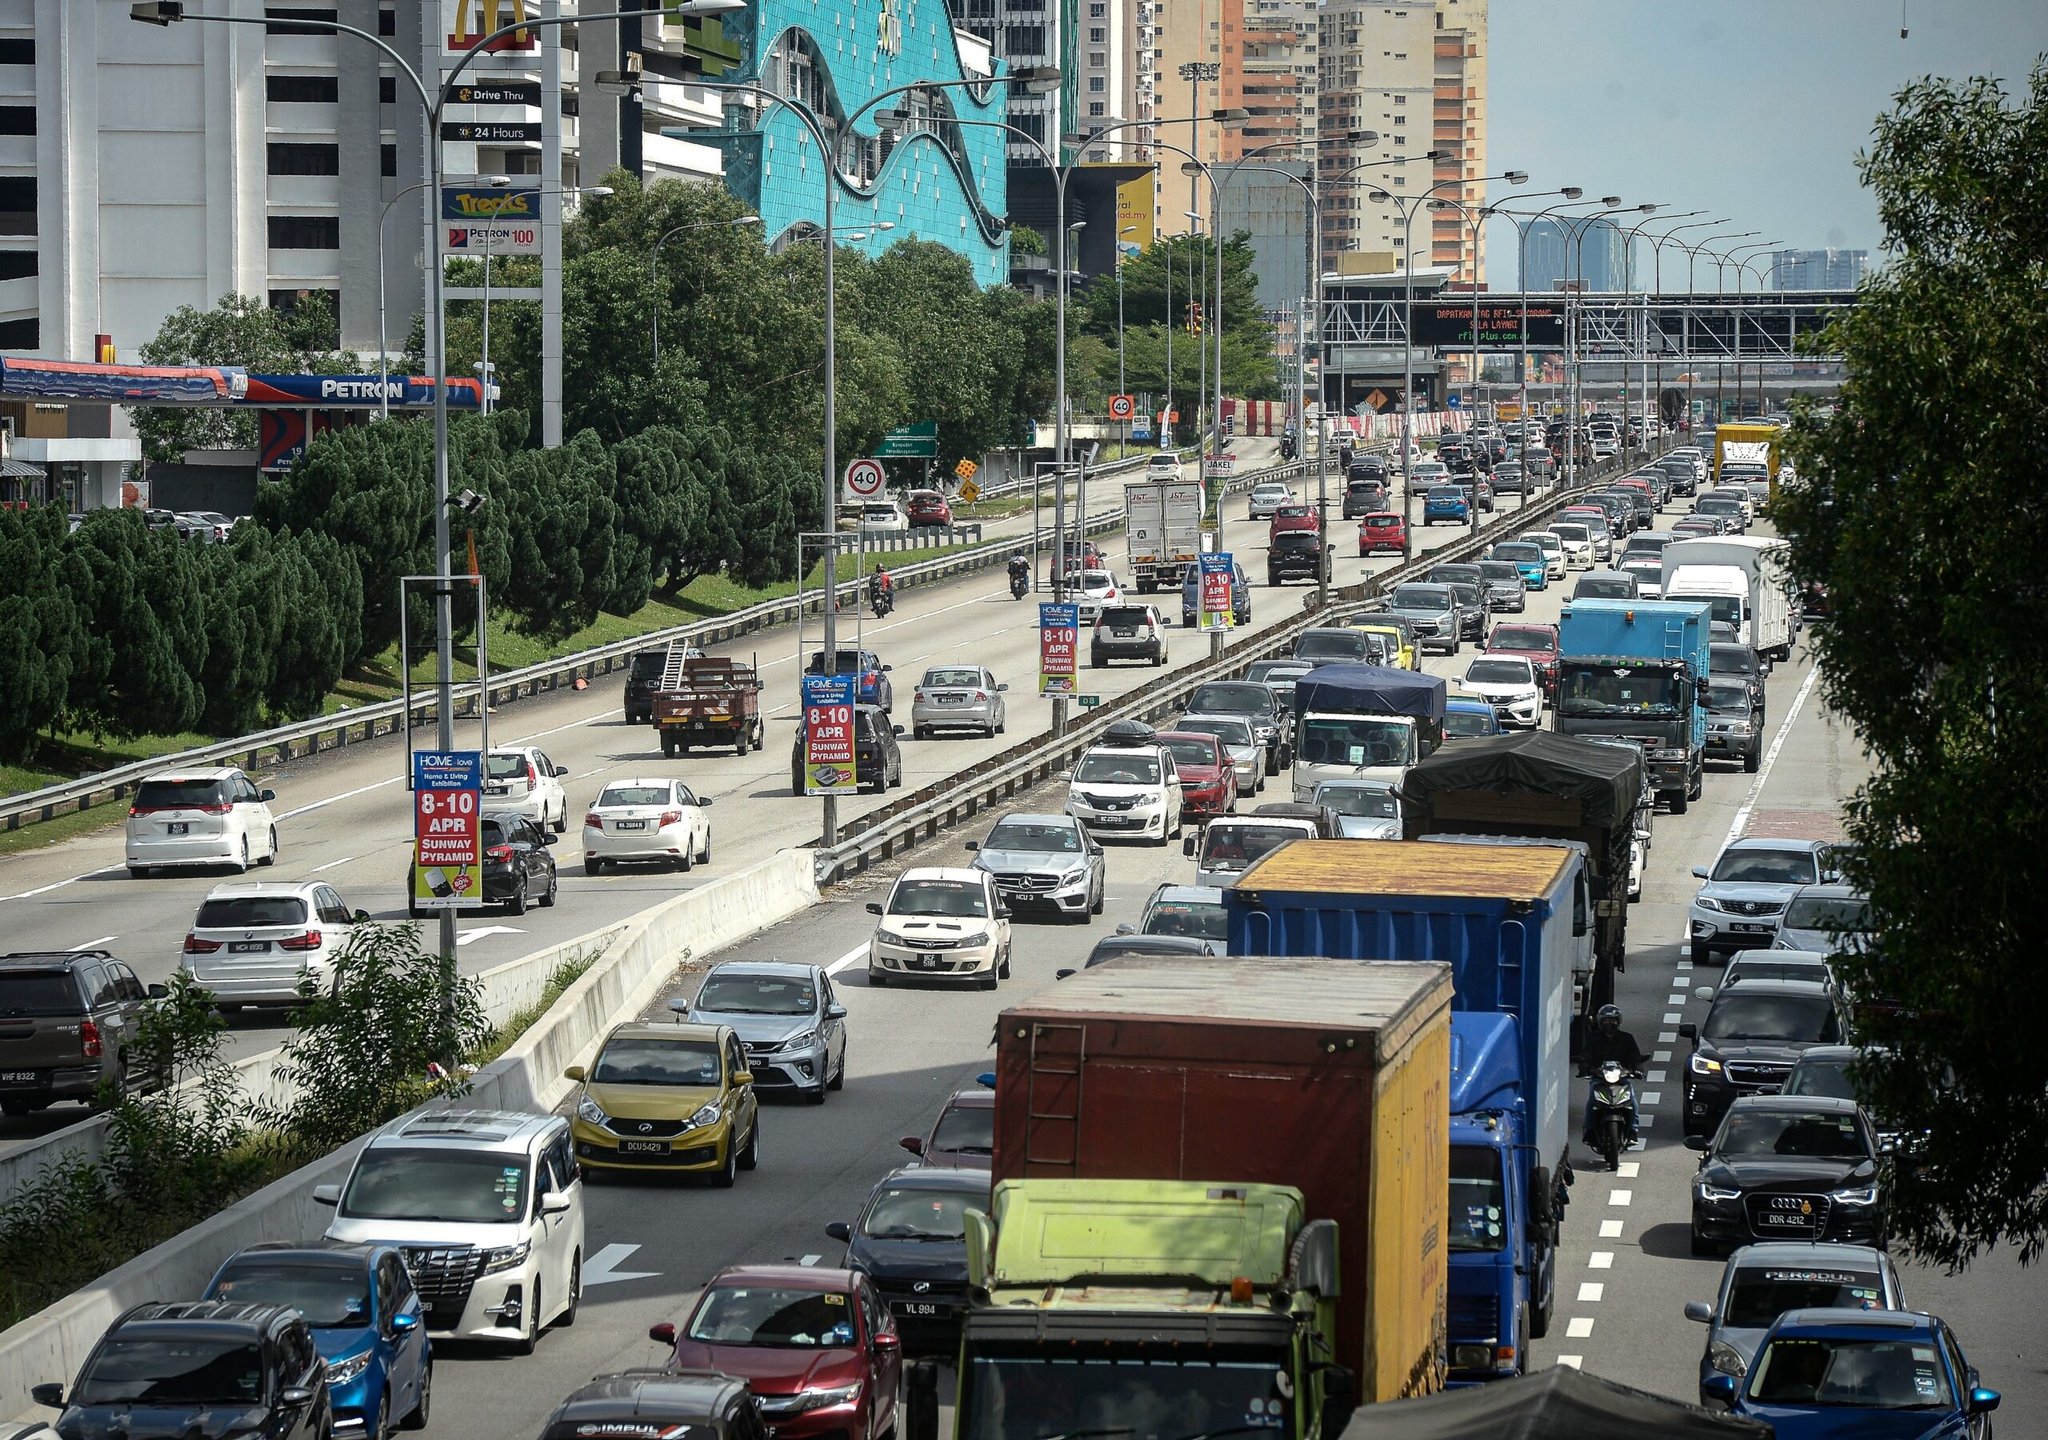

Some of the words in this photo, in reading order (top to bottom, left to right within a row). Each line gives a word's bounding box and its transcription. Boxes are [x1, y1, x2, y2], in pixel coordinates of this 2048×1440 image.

[473, 90, 500, 100] Drive
[503, 91, 524, 100] Thru
[475, 127, 489, 138] 24
[493, 127, 524, 138] Hours
[470, 228, 510, 238] PETRON
[512, 229, 534, 243] 100
[1436, 309, 1473, 318] DAPATKAN
[1476, 309, 1490, 318] TAG
[1469, 320, 1488, 329] SLA
[1491, 320, 1518, 329] LAYARI
[322, 379, 403, 398] PETRON
[1115, 402, 1129, 411] 40
[1207, 461, 1231, 469] JAKEL
[854, 471, 876, 484] 40
[1132, 493, 1148, 501] J&T
[1170, 491, 1186, 499] J&T
[1204, 574, 1228, 586] 8-10
[1208, 587, 1225, 595] APR
[1042, 606, 1062, 614] HOME
[1044, 629, 1073, 643] 8-10
[1048, 644, 1069, 654] APR
[1673, 671, 1680, 680] 6
[807, 680, 832, 689] HOME
[810, 707, 849, 725] 8-10
[816, 727, 844, 738] APR
[811, 743, 848, 751] SUNWAY
[420, 755, 453, 766] HOME
[456, 758, 473, 766] love
[810, 752, 850, 760] PYRAMID
[450, 773, 468, 781] Living
[421, 793, 473, 814] 8-10
[429, 818, 466, 832] APR
[422, 839, 472, 849] SUNWAY
[420, 851, 474, 862] PYRAMID
[1, 1072, 16, 1081] VHF
[16, 1072, 36, 1081] 8322
[1769, 1214, 1785, 1224] DDR
[1786, 1215, 1805, 1225] 4212
[906, 1303, 917, 1314] VL
[918, 1304, 935, 1314] 994
[601, 1424, 659, 1433] IMPUL
